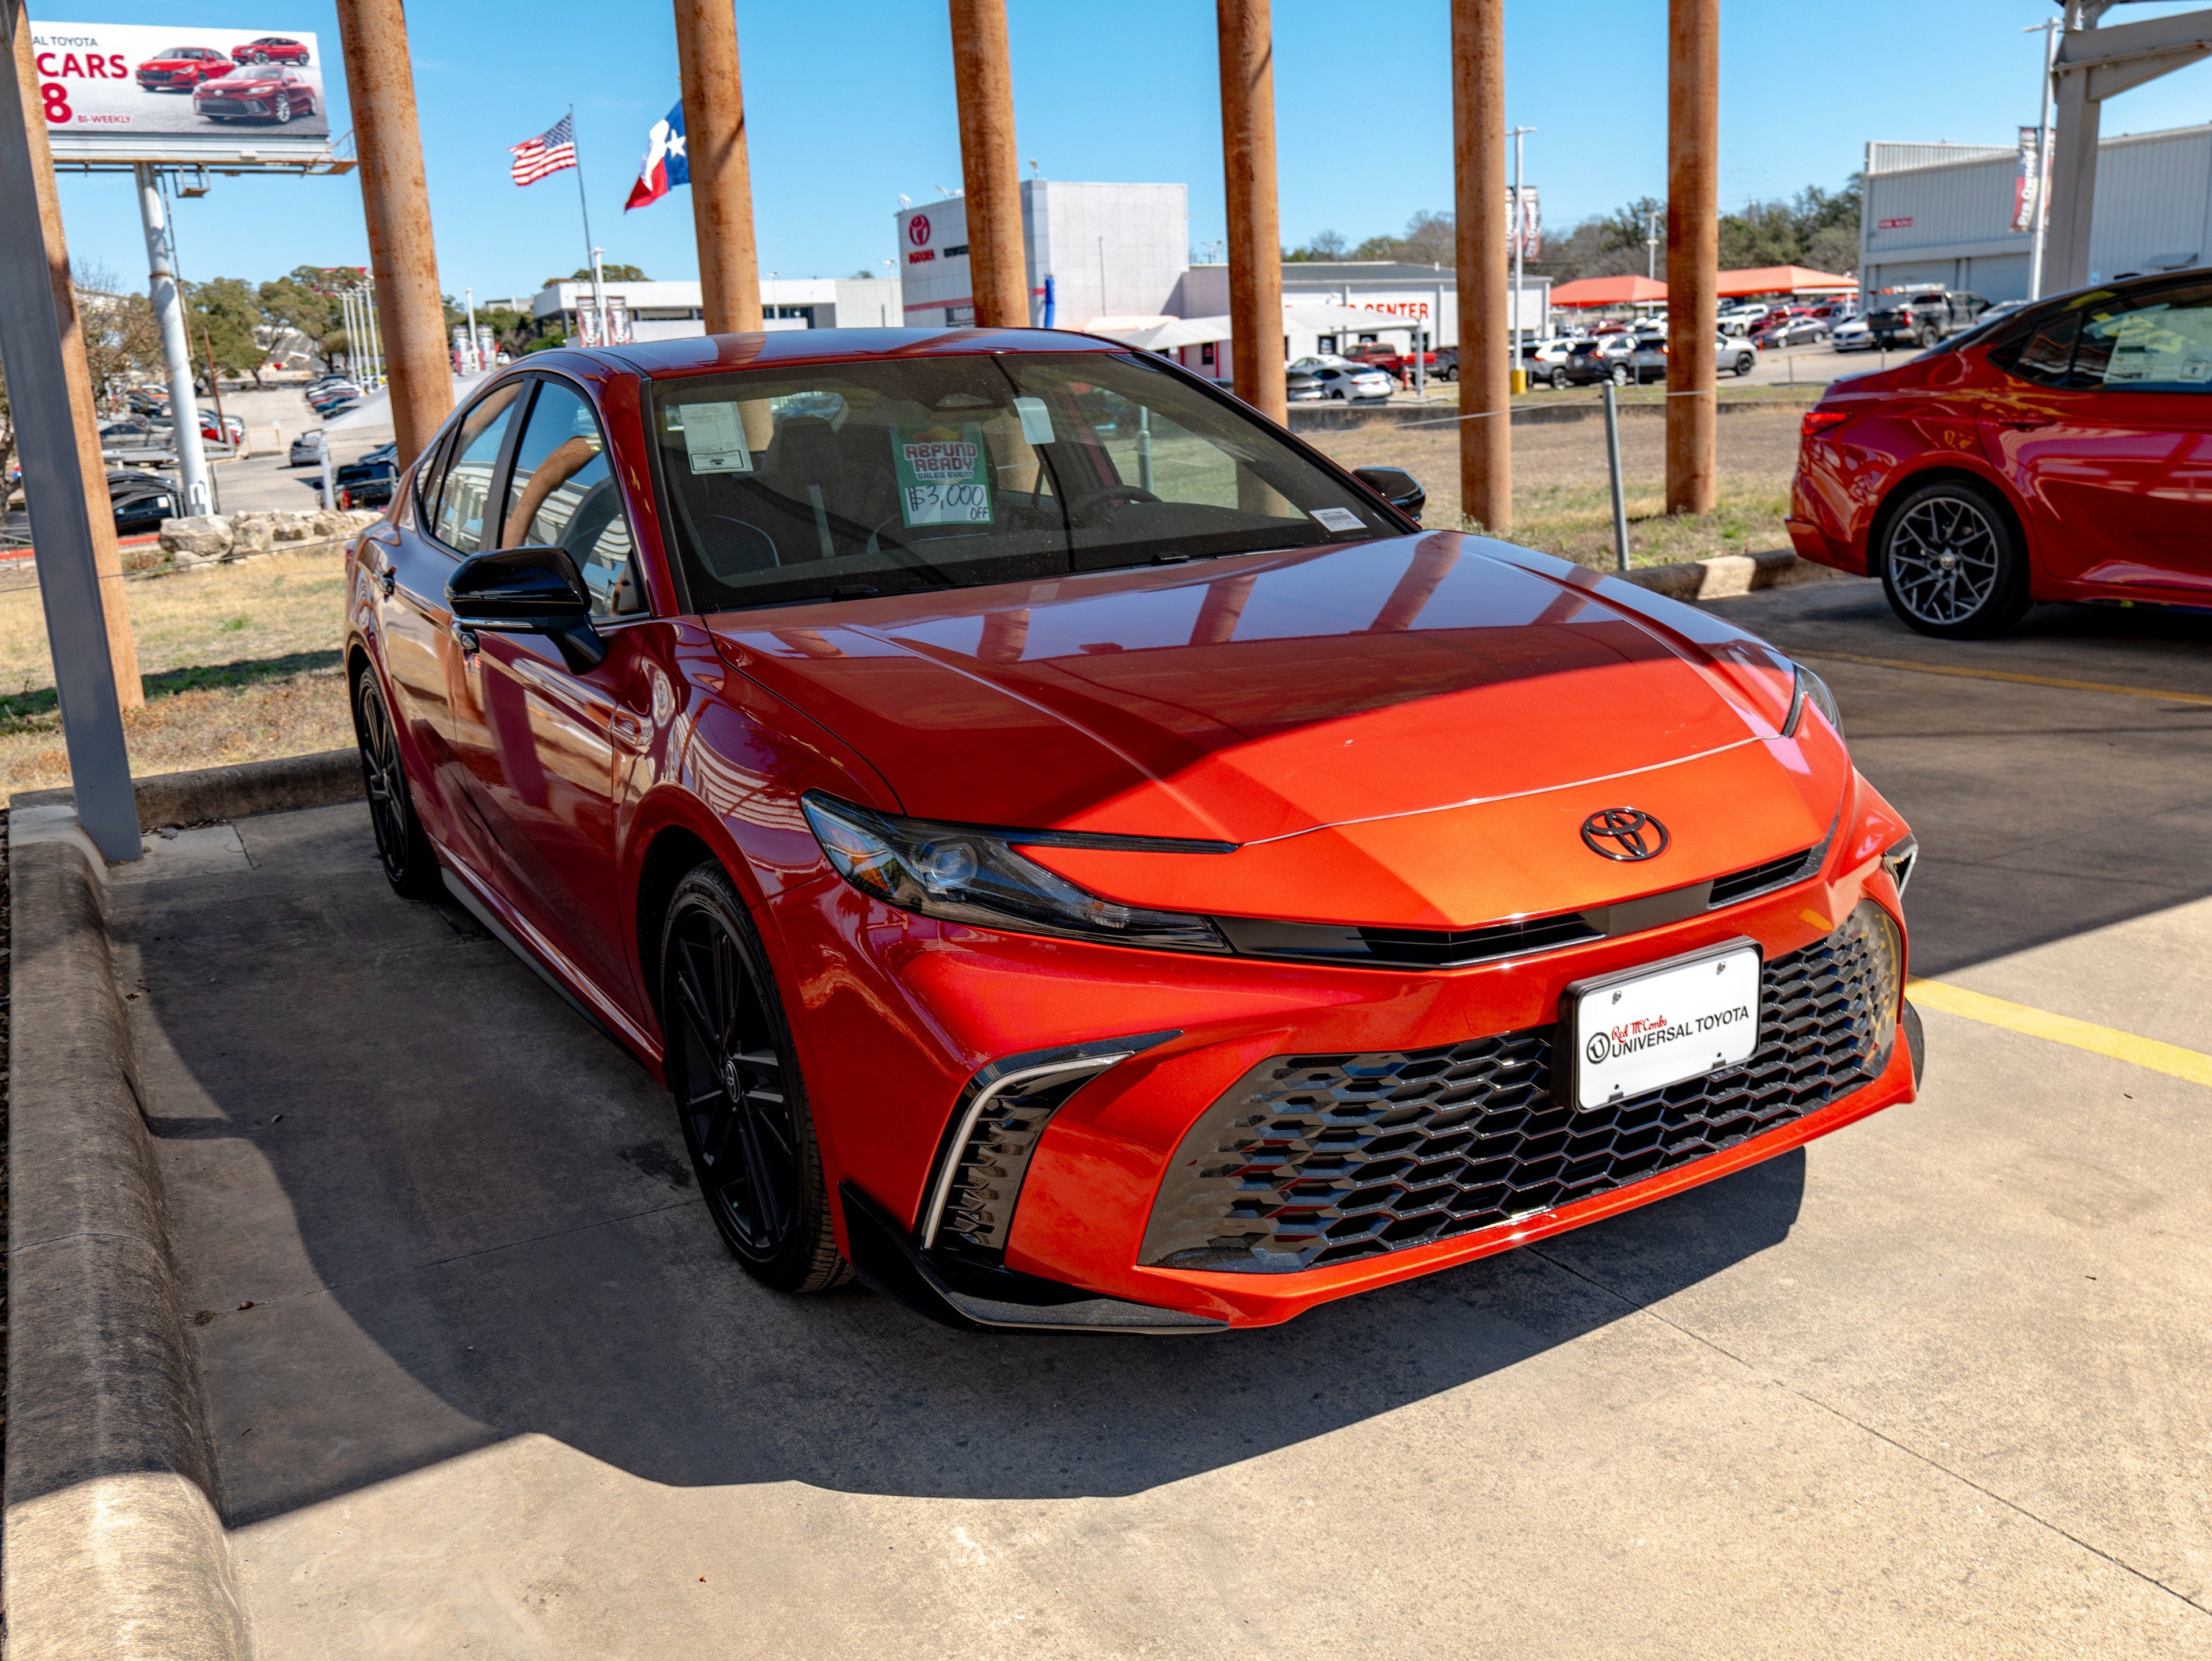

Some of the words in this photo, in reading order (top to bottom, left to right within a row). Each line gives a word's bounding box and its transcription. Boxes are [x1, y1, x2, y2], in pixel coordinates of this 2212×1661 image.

[50, 37, 98, 46] TOYOTA
[36, 52, 128, 79] CARS
[41, 82, 73, 123] 8
[904, 442, 978, 459] REFUND
[914, 457, 974, 472] READY
[908, 484, 983, 512] $3,000
[970, 507, 989, 520] OFF
[1612, 1022, 1693, 1058] UNIVERSAL
[1695, 1005, 1749, 1032] TOYOTA
[1612, 1024, 1628, 1043] Red
